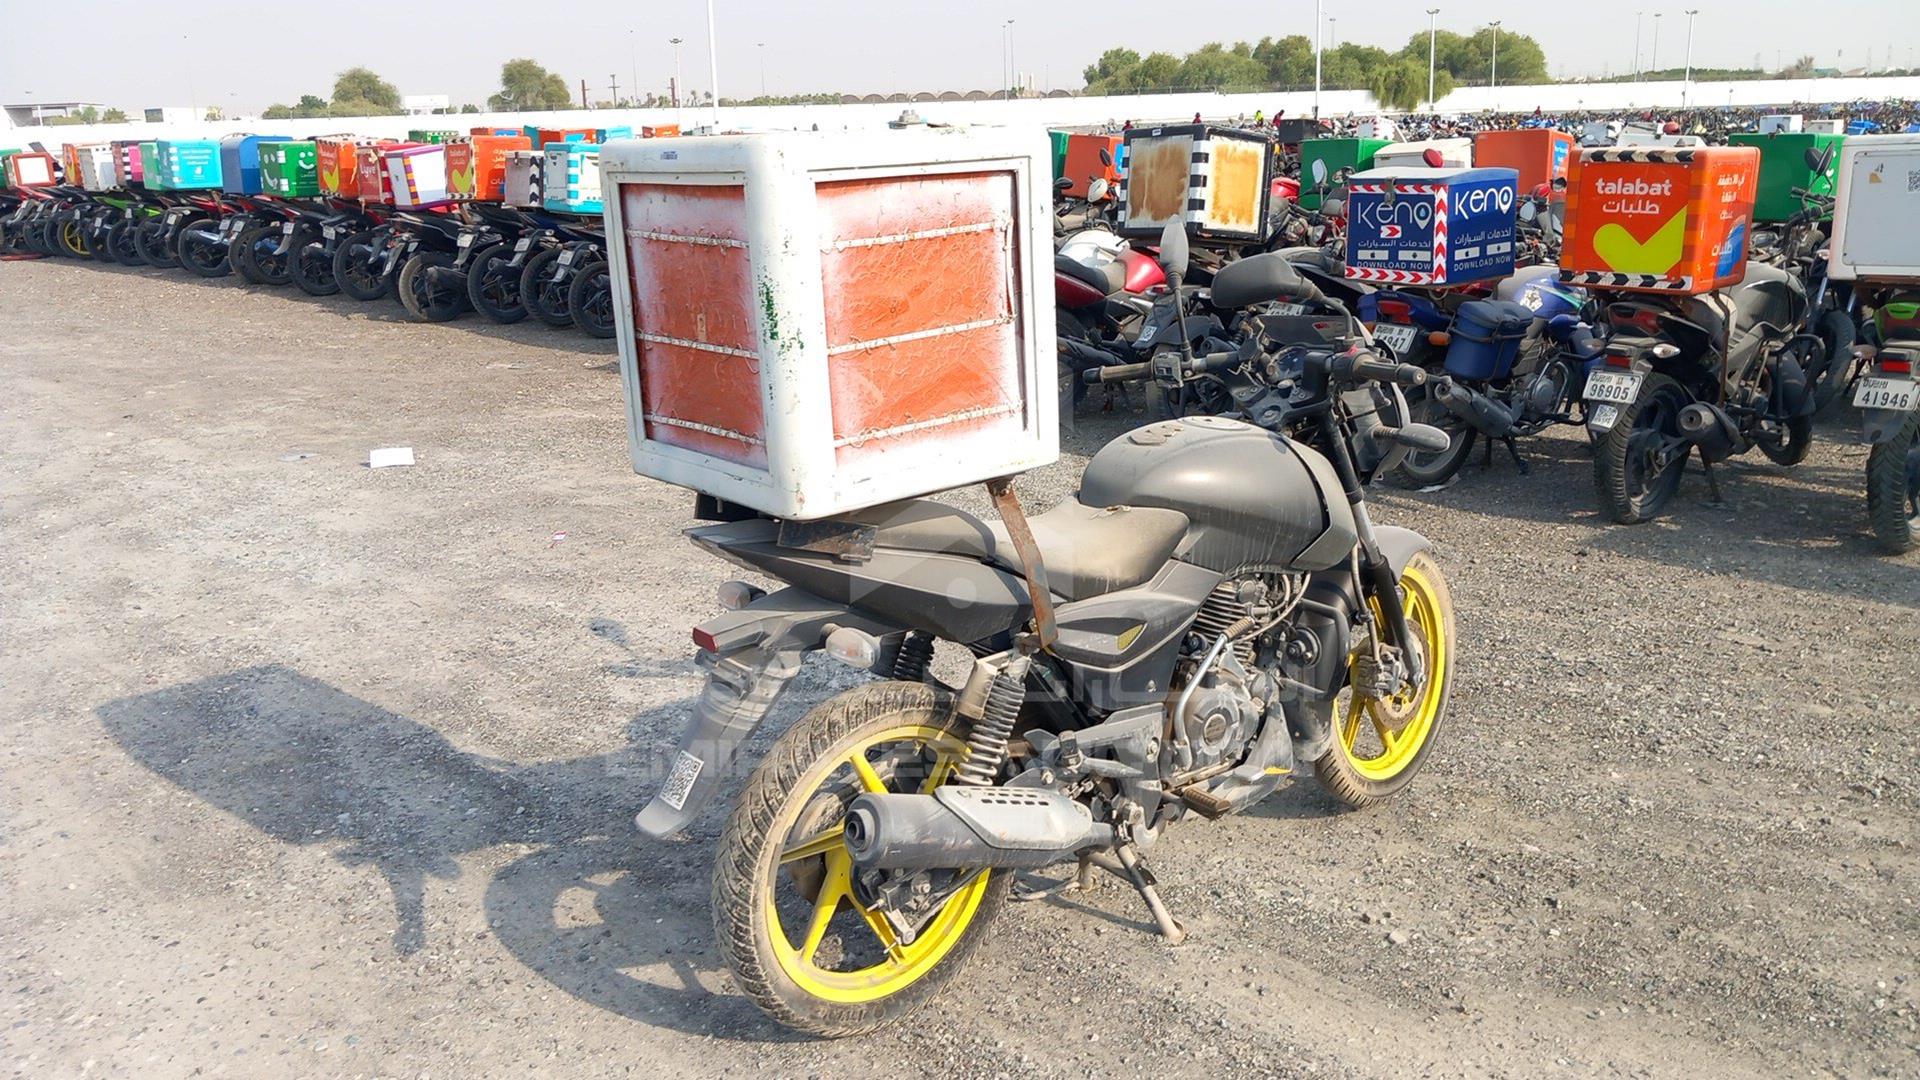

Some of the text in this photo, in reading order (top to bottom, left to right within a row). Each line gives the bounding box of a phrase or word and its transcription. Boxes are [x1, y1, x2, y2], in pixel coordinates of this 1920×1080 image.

[1595, 177, 1672, 196] talabat
[1602, 199, 1659, 218] طلبات
[1358, 240, 1431, 248] لخدمات السيارات
[1455, 227, 1511, 246] لخدمات السيارات
[1357, 261, 1431, 270] DOWNLOAD NOW
[1454, 255, 1511, 271] DOWNLOAD NOW
[1590, 384, 1629, 400] 96905
[1862, 391, 1909, 408] 41946
